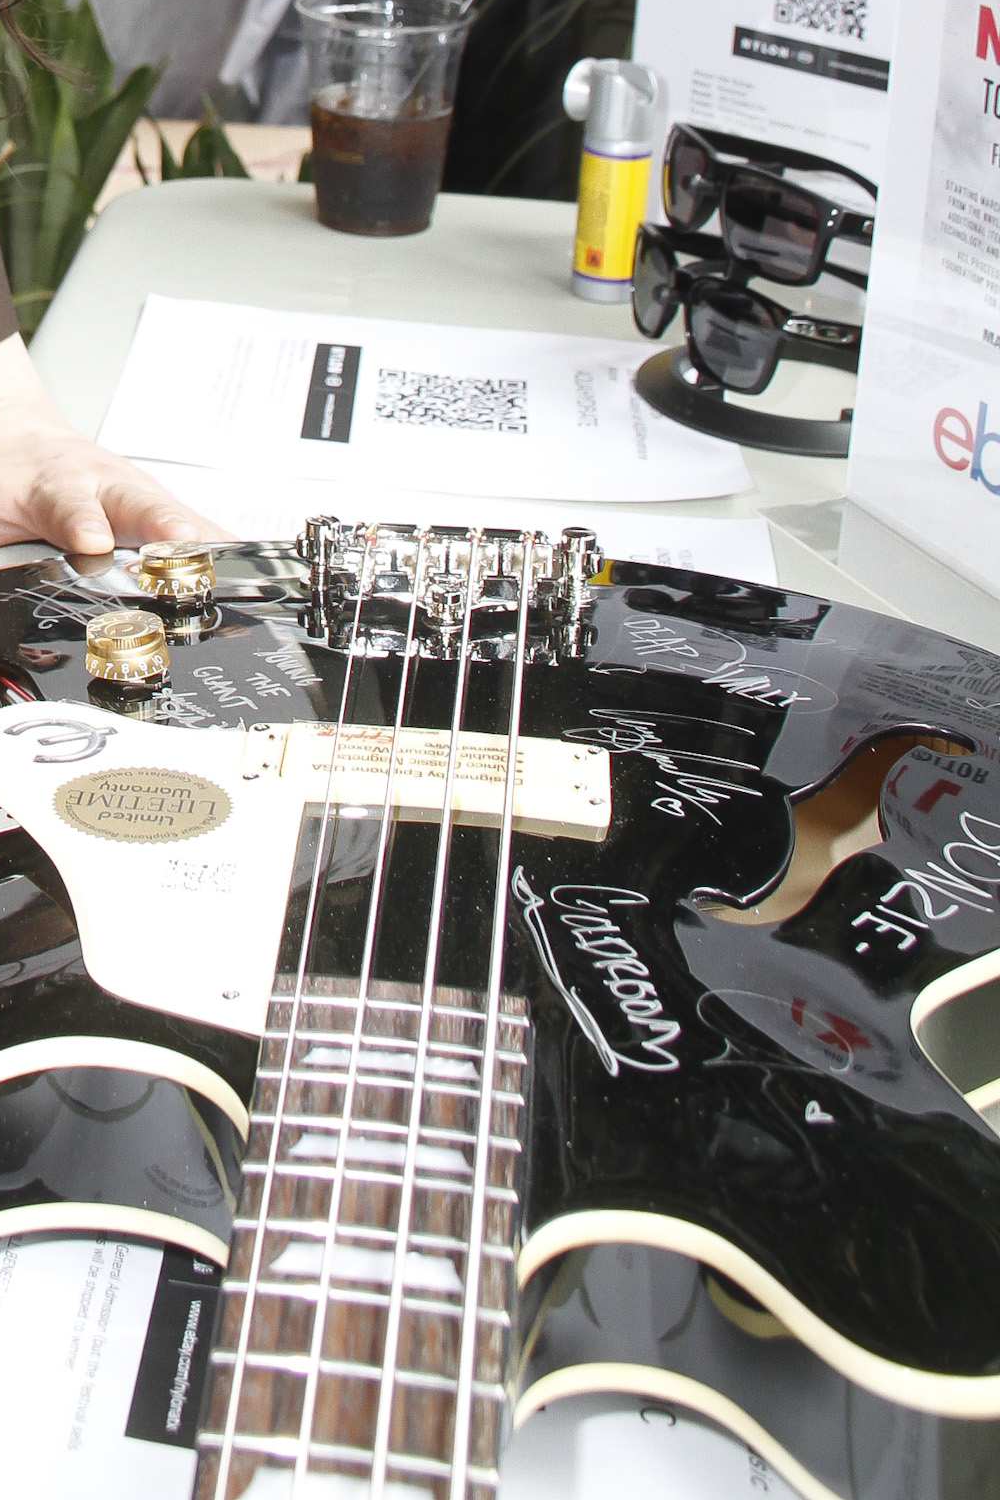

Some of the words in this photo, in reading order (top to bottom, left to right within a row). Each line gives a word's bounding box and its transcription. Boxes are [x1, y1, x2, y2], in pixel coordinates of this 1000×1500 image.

[740, 37, 790, 59] NYLON
[156, 579, 166, 591] 7
[172, 580, 181, 591] 8
[188, 579, 197, 589] 9
[199, 575, 211, 586] 10
[105, 662, 115, 674] 7
[120, 662, 130, 674] 8
[138, 661, 148, 672] 9
[151, 654, 164, 666] 10
[253, 646, 323, 687] YOUNG
[245, 672, 291, 697] THE
[338, 743, 391, 754] Waxed
[337, 752, 405, 766] Magnets
[409, 757, 461, 769] Cassic
[427, 768, 446, 779] by
[454, 772, 523, 786] Dsigne
[99, 780, 191, 799] Warranty
[65, 789, 218, 816] LIFETIME
[97, 811, 174, 826] Limited
[91, 1248, 107, 1267] will
[108, 1244, 130, 1283] General
[87, 1265, 100, 1279] be
[98, 1281, 120, 1334] Admission
